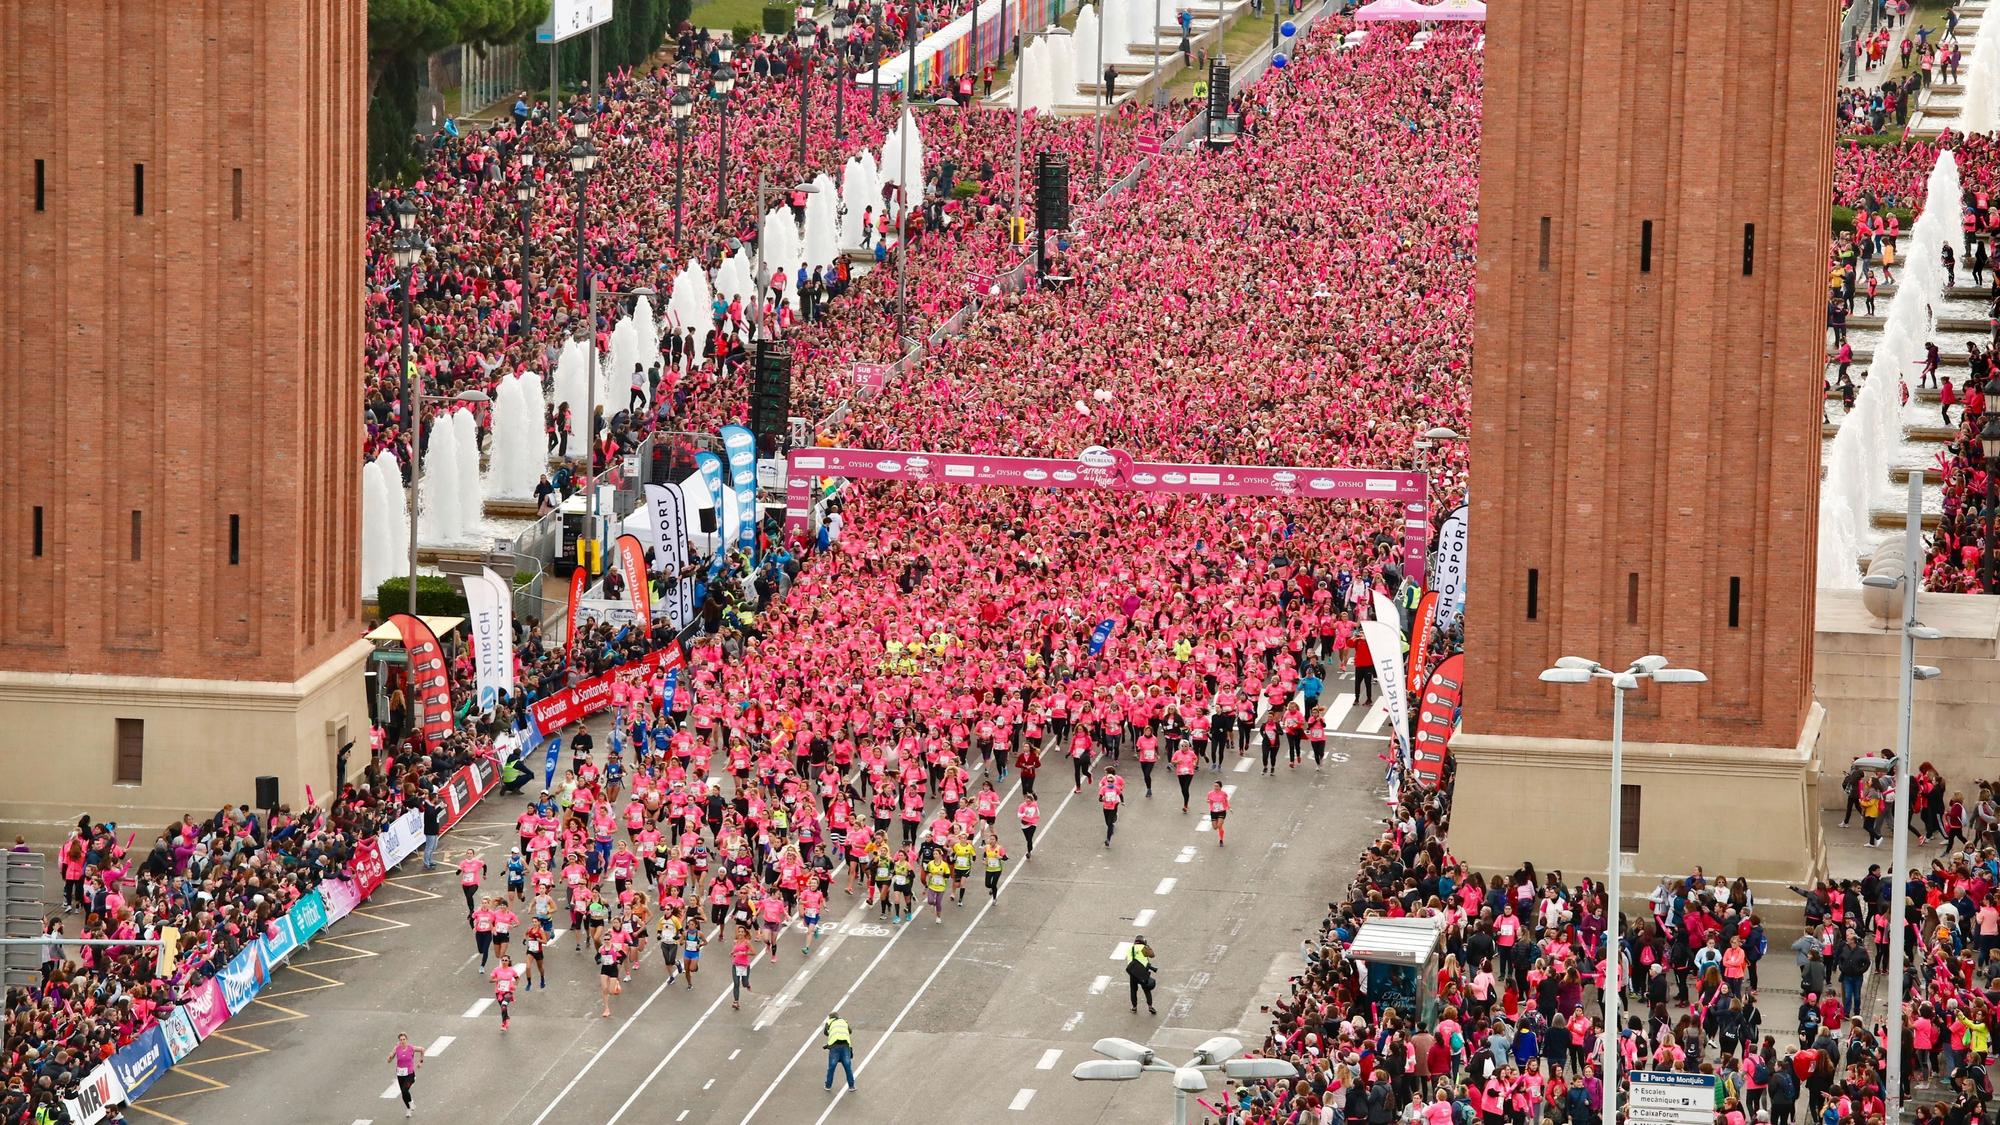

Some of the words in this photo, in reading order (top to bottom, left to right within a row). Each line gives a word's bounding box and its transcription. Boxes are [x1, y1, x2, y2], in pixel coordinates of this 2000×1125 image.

[966, 273, 980, 282] SUB
[857, 366, 872, 374] SUB
[856, 374, 872, 383] 35'
[1076, 465, 1106, 475] Carrera
[1094, 474, 1118, 488] Mujer
[1415, 603, 1434, 672] Santander
[578, 680, 609, 702] Santander
[542, 699, 567, 720] Santander
[132, 1043, 160, 1078] MICHELIN
[1650, 1074, 1666, 1082] Parc
[1666, 1075, 1675, 1083] de
[1640, 1087, 1666, 1095] Escales
[77, 1073, 110, 1120] MRW
[1640, 1109, 1679, 1118] CaixaForum
